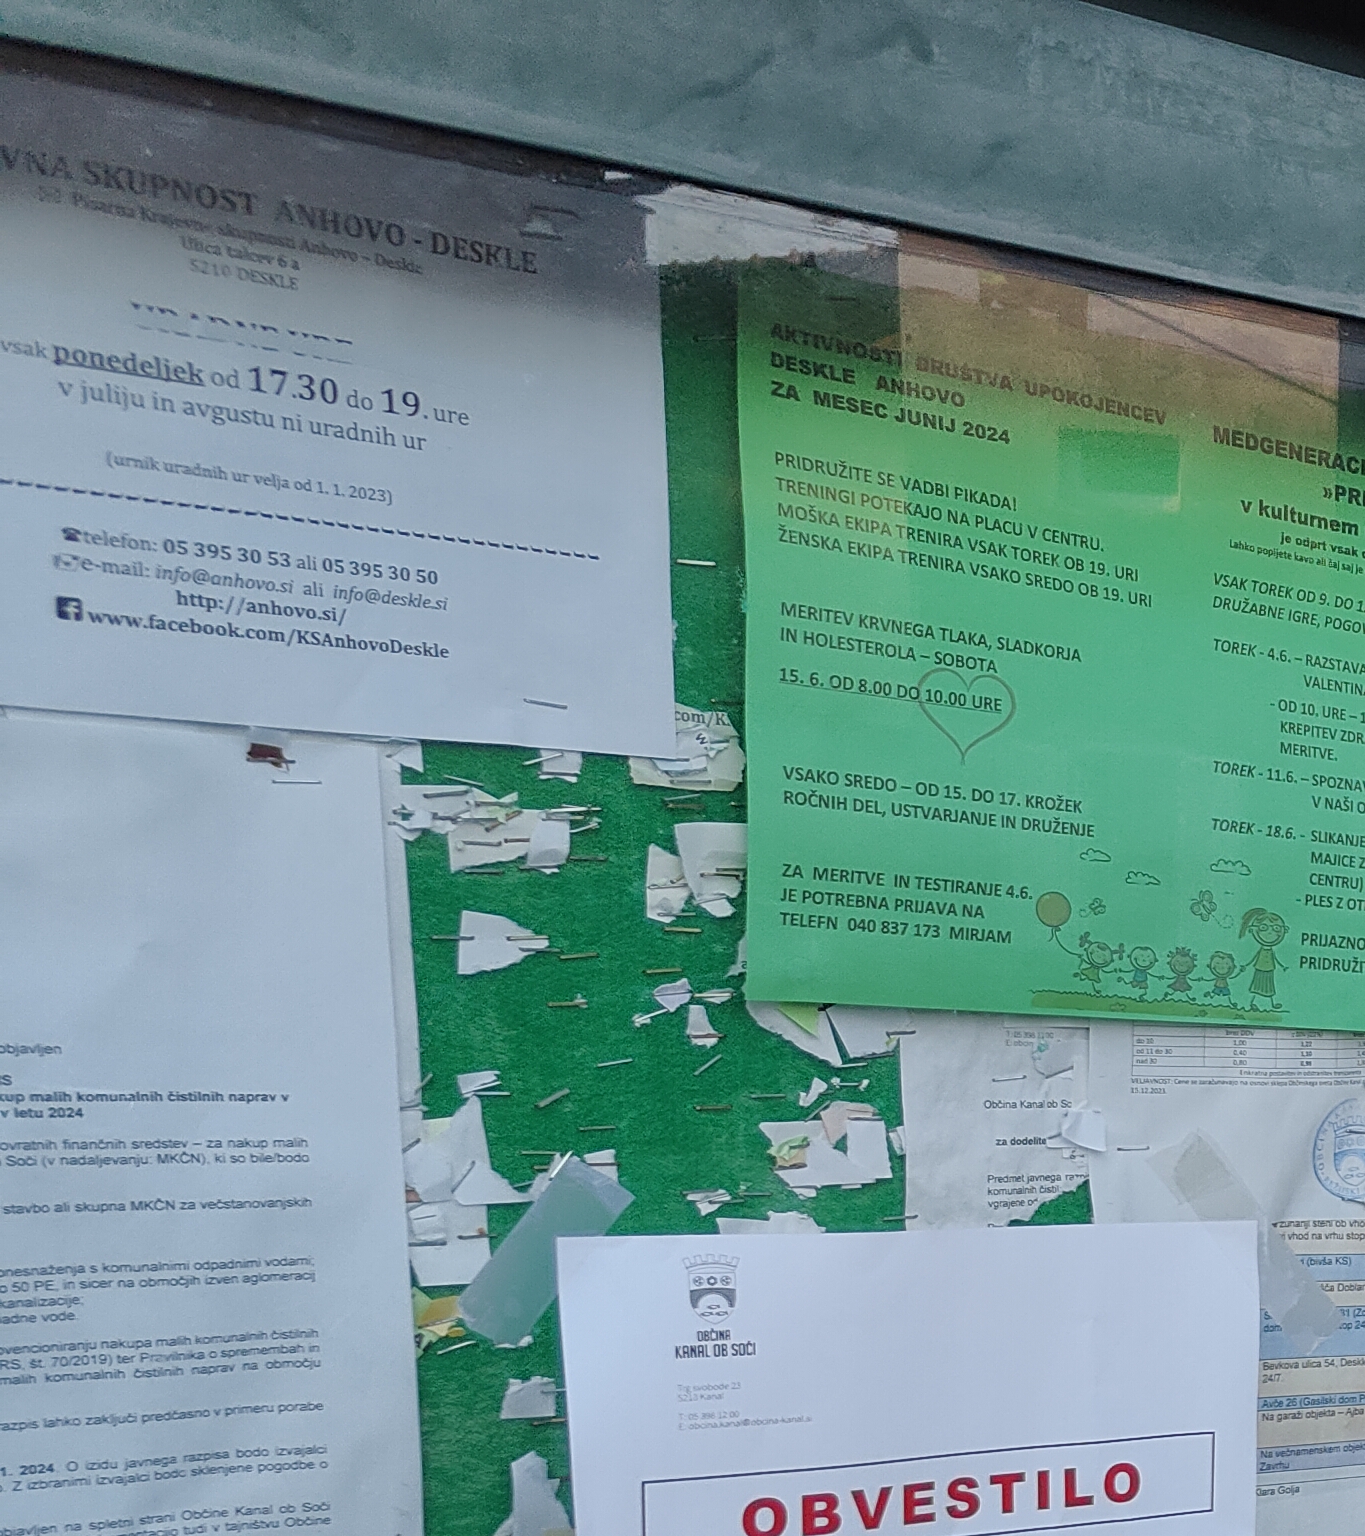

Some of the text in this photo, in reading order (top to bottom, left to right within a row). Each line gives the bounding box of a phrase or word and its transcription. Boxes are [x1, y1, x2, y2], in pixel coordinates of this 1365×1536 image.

[83, 160, 259, 216] SKUPNOST
[274, 199, 406, 247] ANHOVO
[428, 229, 538, 275] DESKLE
[53, 346, 204, 387] ponedeljek
[212, 369, 239, 388] od
[249, 367, 337, 405] 17.30
[347, 389, 372, 411] do
[382, 389, 427, 419] 19.
[434, 408, 468, 426] ure
[770, 322, 1168, 425] AKTIVNOSTI DRUŠTVA UPOKOJENCEV
[770, 350, 965, 408] DESKLE ANHOVO
[58, 380, 426, 451] v juliju in avgustu ni uradnih ur
[771, 379, 1010, 445] ZA MESEC JUNIJ 2024
[775, 451, 1016, 512] PRIDRUŽITE SE VADBI PIKADA!
[1241, 499, 1252, 514] v
[1259, 499, 1358, 537] kulturnem
[76, 529, 437, 585] telefon: 05 395 30 53 ali 05 395 30 50
[76, 555, 448, 611] e-mail: info@anhovo.si ali info@deskle.si
[176, 589, 346, 626] http://anhovo.si/
[88, 613, 450, 659] www.facebook.com/KSAnhovoDeskle
[780, 912, 1011, 944] TELEFN 040 837 173 MIRJAM
[1302, 932, 1365, 951] PRIJAZNO
[14, 1107, 43, 1119] letu
[676, 1341, 756, 1359] KANAL OB SOČI
[697, 1328, 730, 1342] OBČINA
